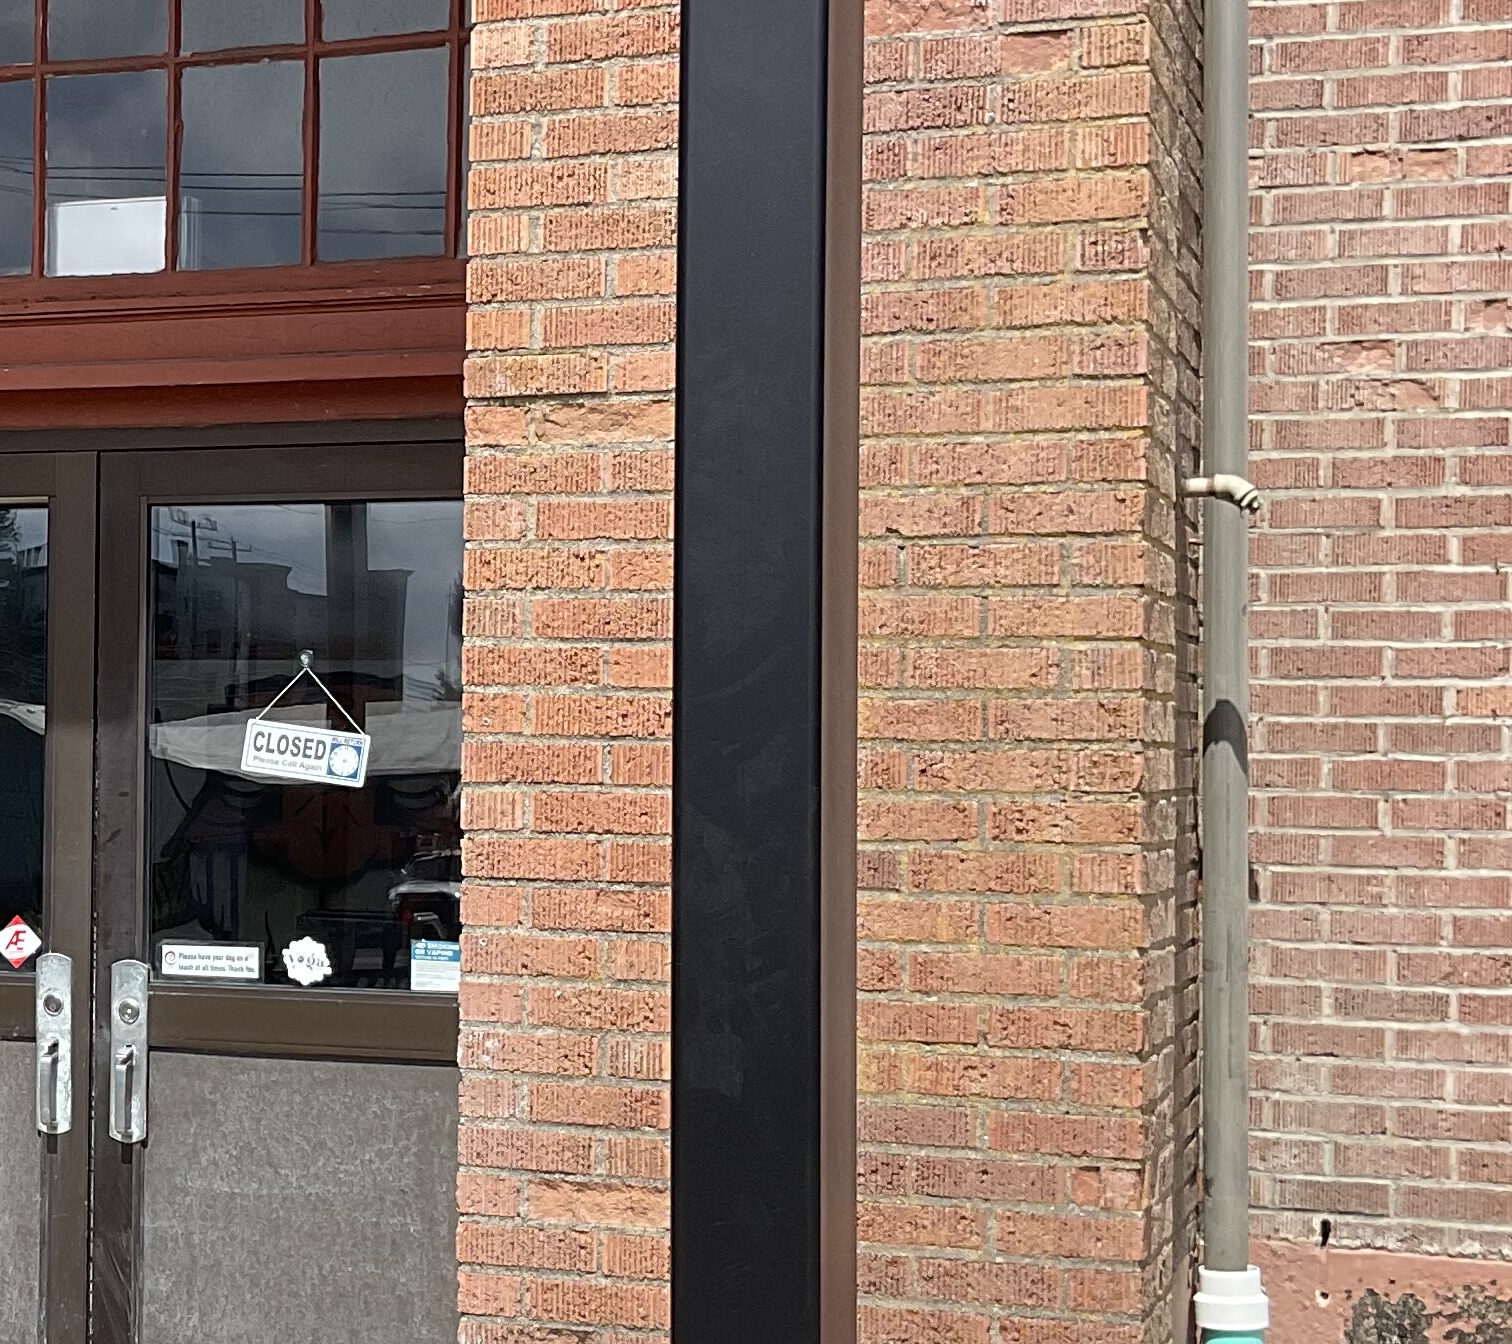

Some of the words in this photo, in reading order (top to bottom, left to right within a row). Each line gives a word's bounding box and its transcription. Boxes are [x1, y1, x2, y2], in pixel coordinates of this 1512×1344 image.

[253, 731, 327, 760] CLOSED
[253, 755, 280, 766] Please
[281, 759, 297, 768] Call
[299, 762, 323, 771] Again
[178, 952, 197, 960] Please
[225, 954, 235, 962] dog
